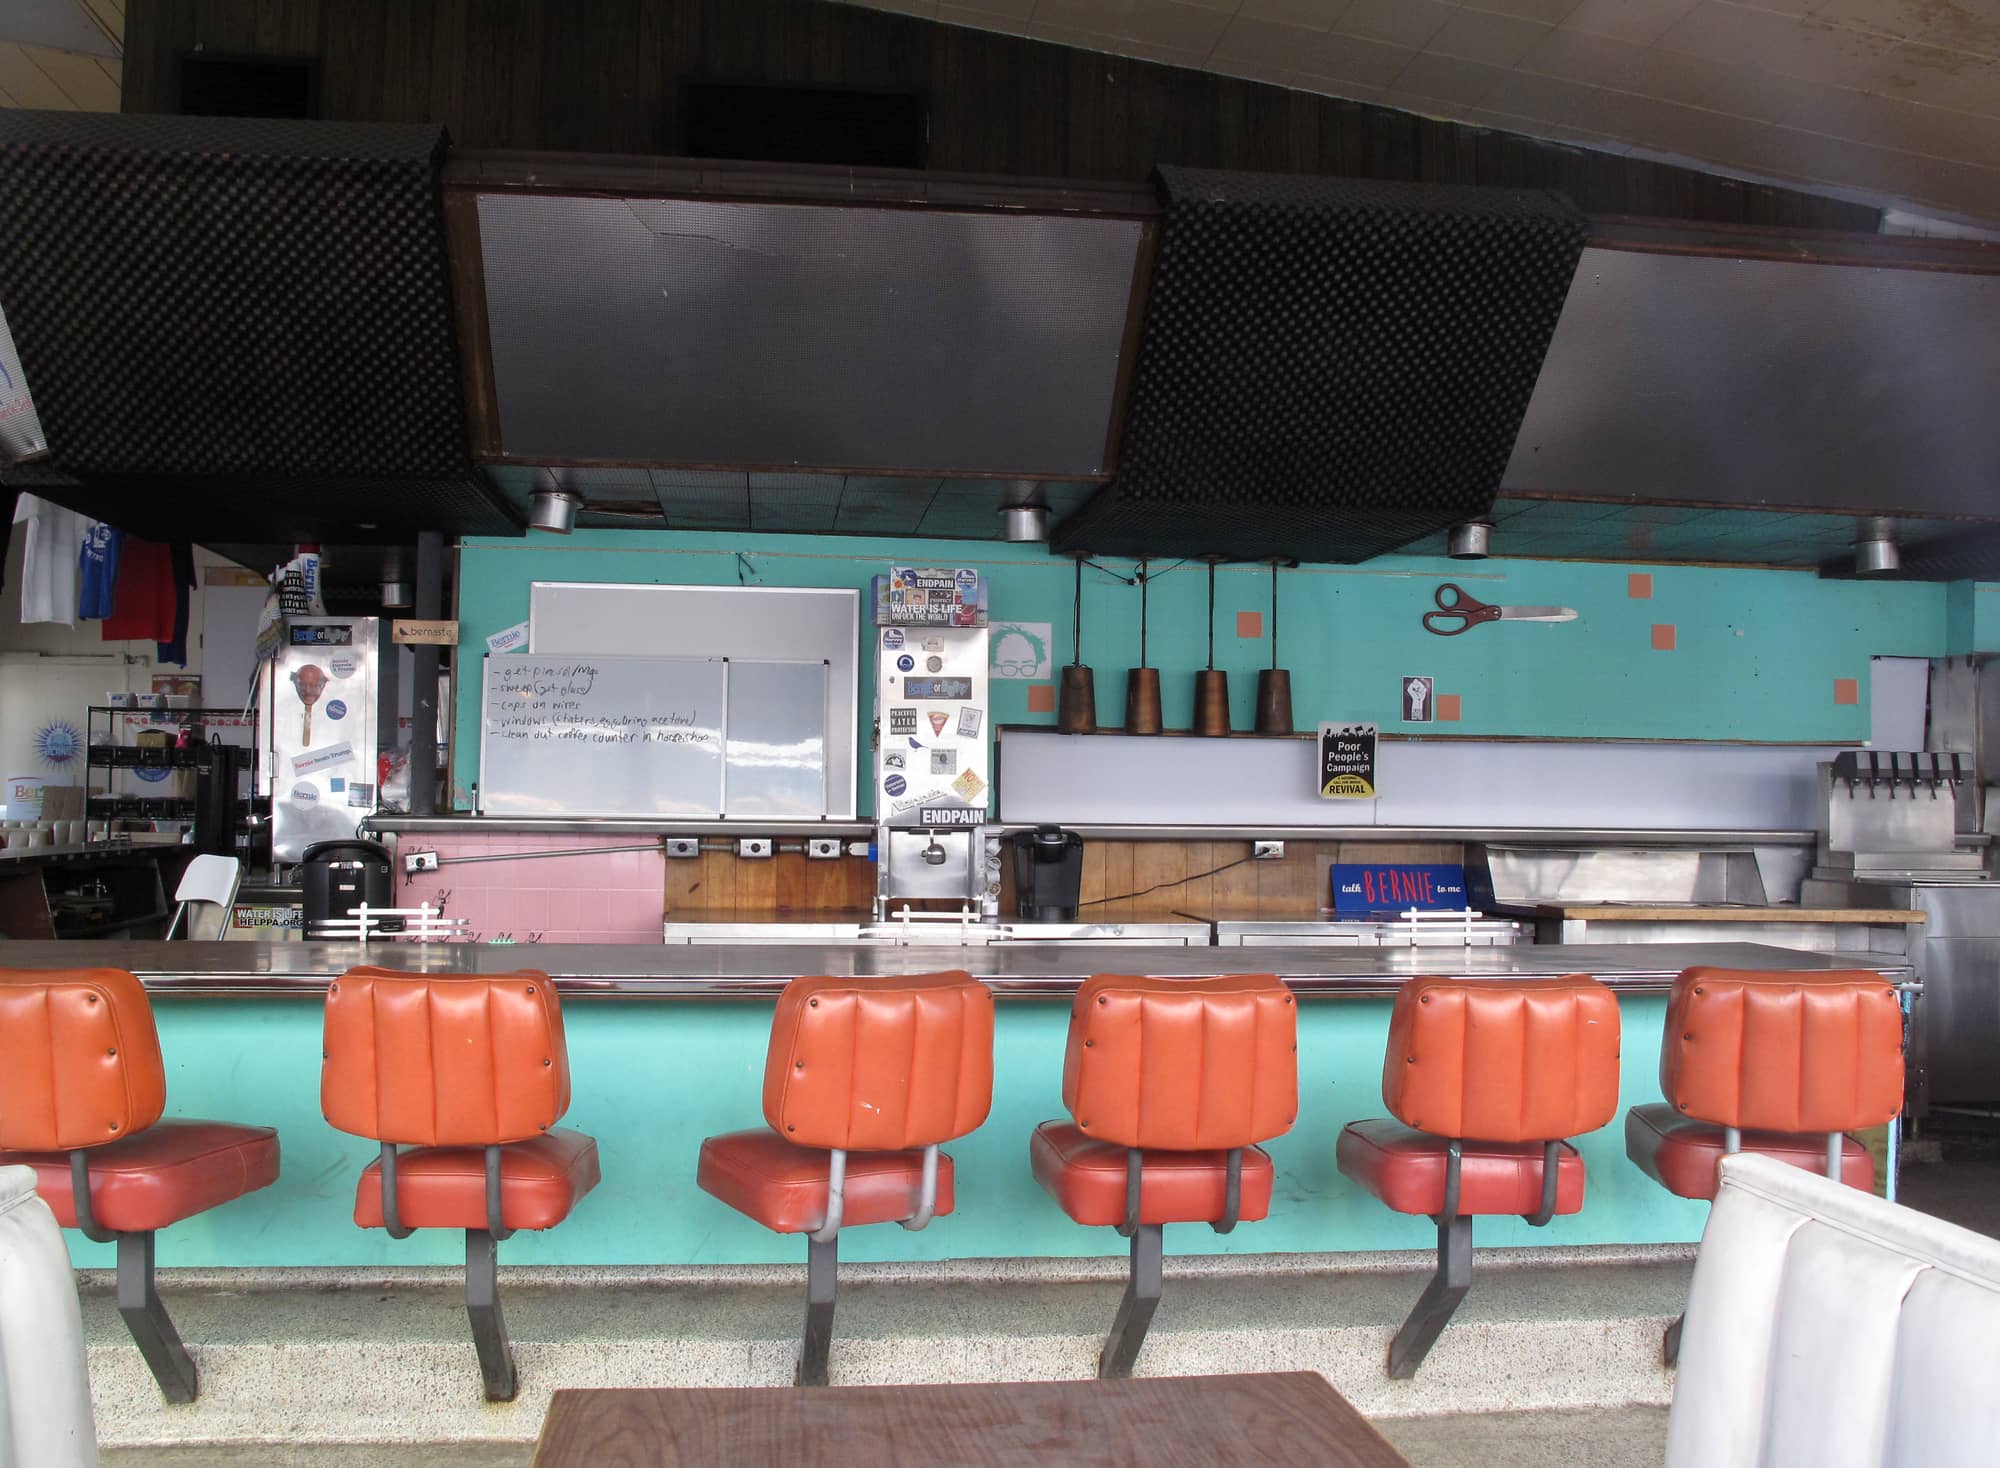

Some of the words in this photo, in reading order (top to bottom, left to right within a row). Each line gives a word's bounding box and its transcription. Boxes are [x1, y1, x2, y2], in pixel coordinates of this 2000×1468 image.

[917, 579, 954, 588] ENDPAIN
[891, 604, 926, 614] WATER
[930, 605, 940, 613] IS
[942, 605, 962, 613] LIFE
[927, 613, 948, 621] WORLD
[490, 630, 520, 647] Bernie
[501, 684, 533, 696] sweep
[501, 701, 526, 712] caps
[532, 701, 546, 710] on
[891, 718, 916, 726] WATER
[501, 730, 529, 740] clean
[534, 728, 553, 739] out
[558, 727, 588, 741] coffee
[592, 729, 639, 743] counter
[643, 730, 652, 743] in
[1338, 742, 1361, 751] Poor
[1328, 752, 1369, 763] People's
[1326, 763, 1370, 774] Campaign
[15, 785, 44, 798] Ber
[1329, 785, 1366, 794] REVIVAL
[922, 809, 984, 824] ENDPAIN
[1342, 883, 1362, 893] talk
[1363, 869, 1436, 904] BERNIE
[1437, 885, 1446, 893] to
[237, 909, 270, 919] WATER
[272, 909, 282, 919] IS
[284, 910, 303, 919] LIFE
